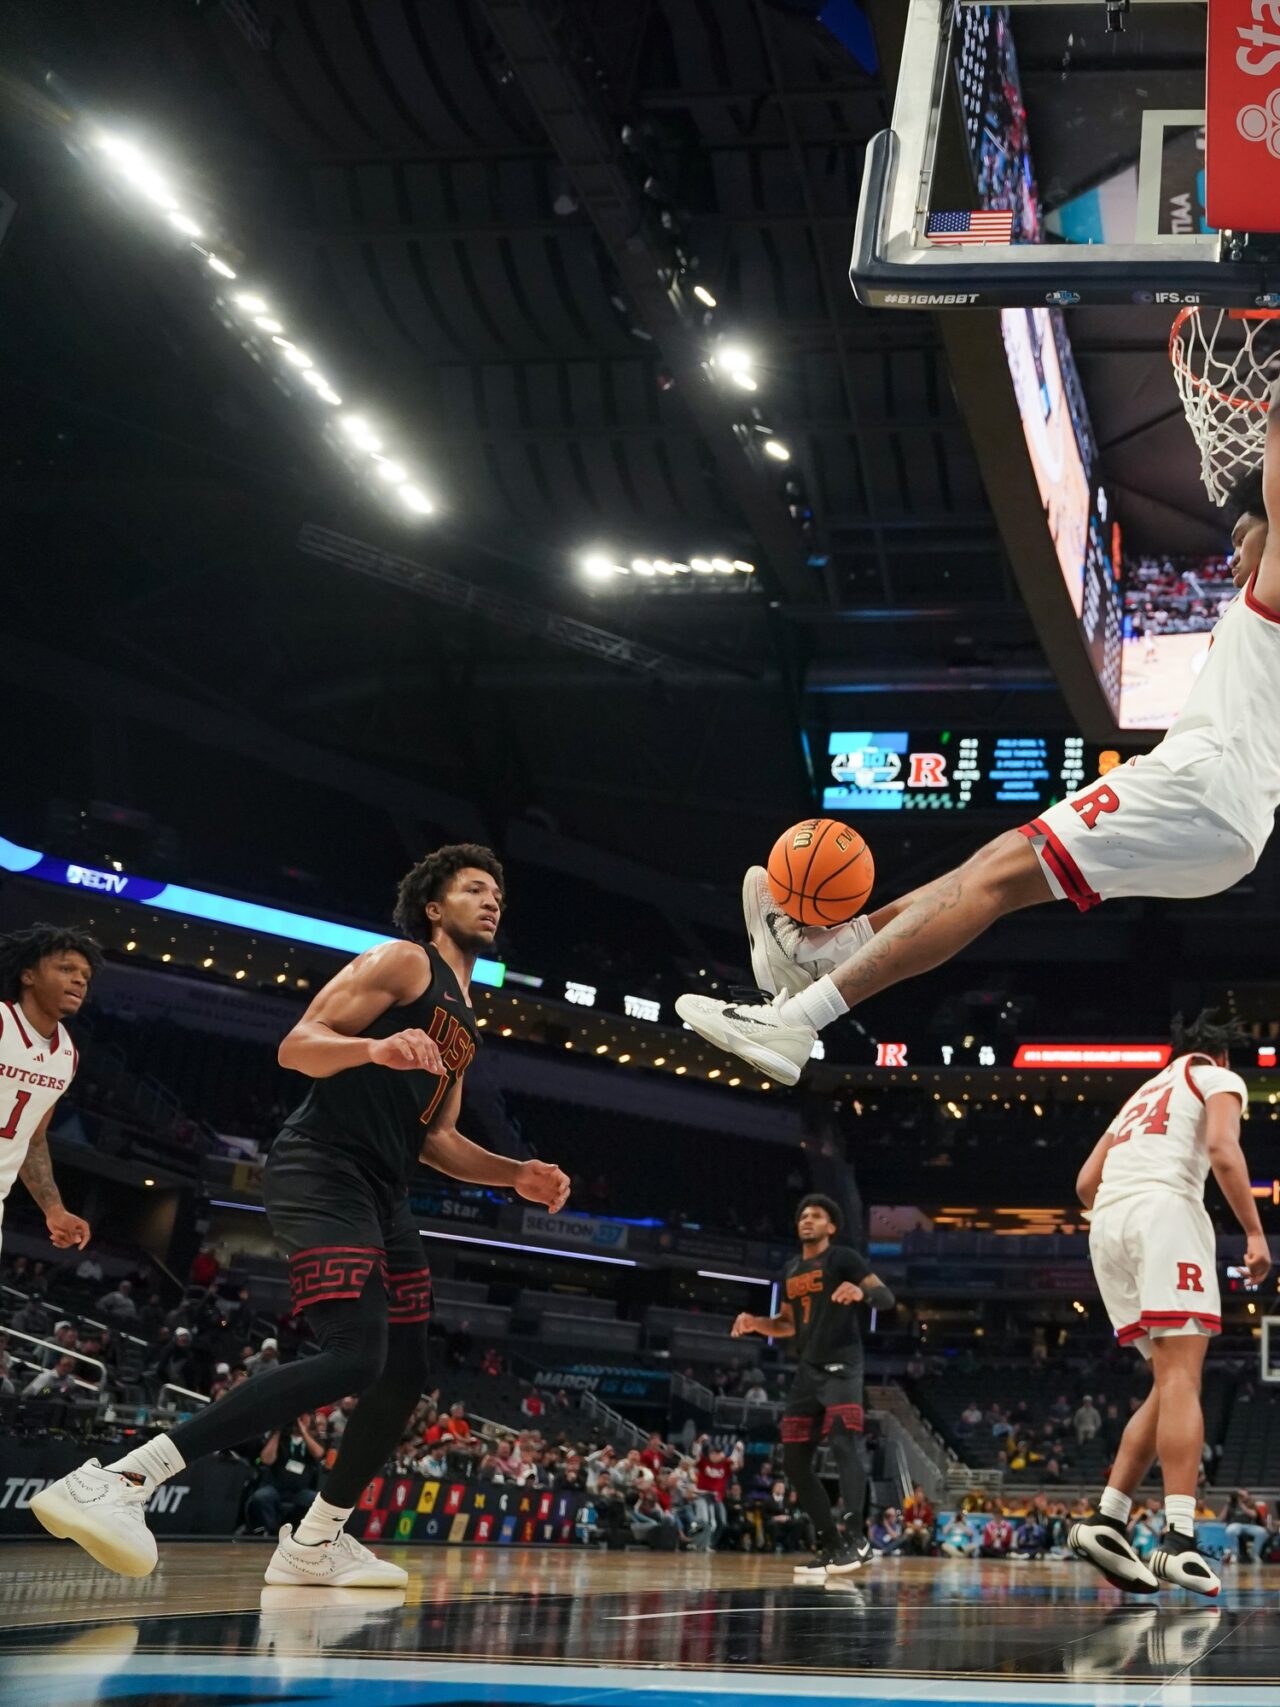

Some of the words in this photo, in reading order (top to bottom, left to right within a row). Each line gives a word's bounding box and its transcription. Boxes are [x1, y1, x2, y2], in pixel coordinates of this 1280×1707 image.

[1155, 292, 1200, 304] IFS.ai
[1070, 784, 1120, 830] R
[0, 1063, 66, 1091] RUTGERS
[0, 1089, 32, 1140] 1
[1108, 1086, 1175, 1149] 24
[527, 1215, 594, 1237] SECTION
[1176, 1262, 1204, 1292] R
